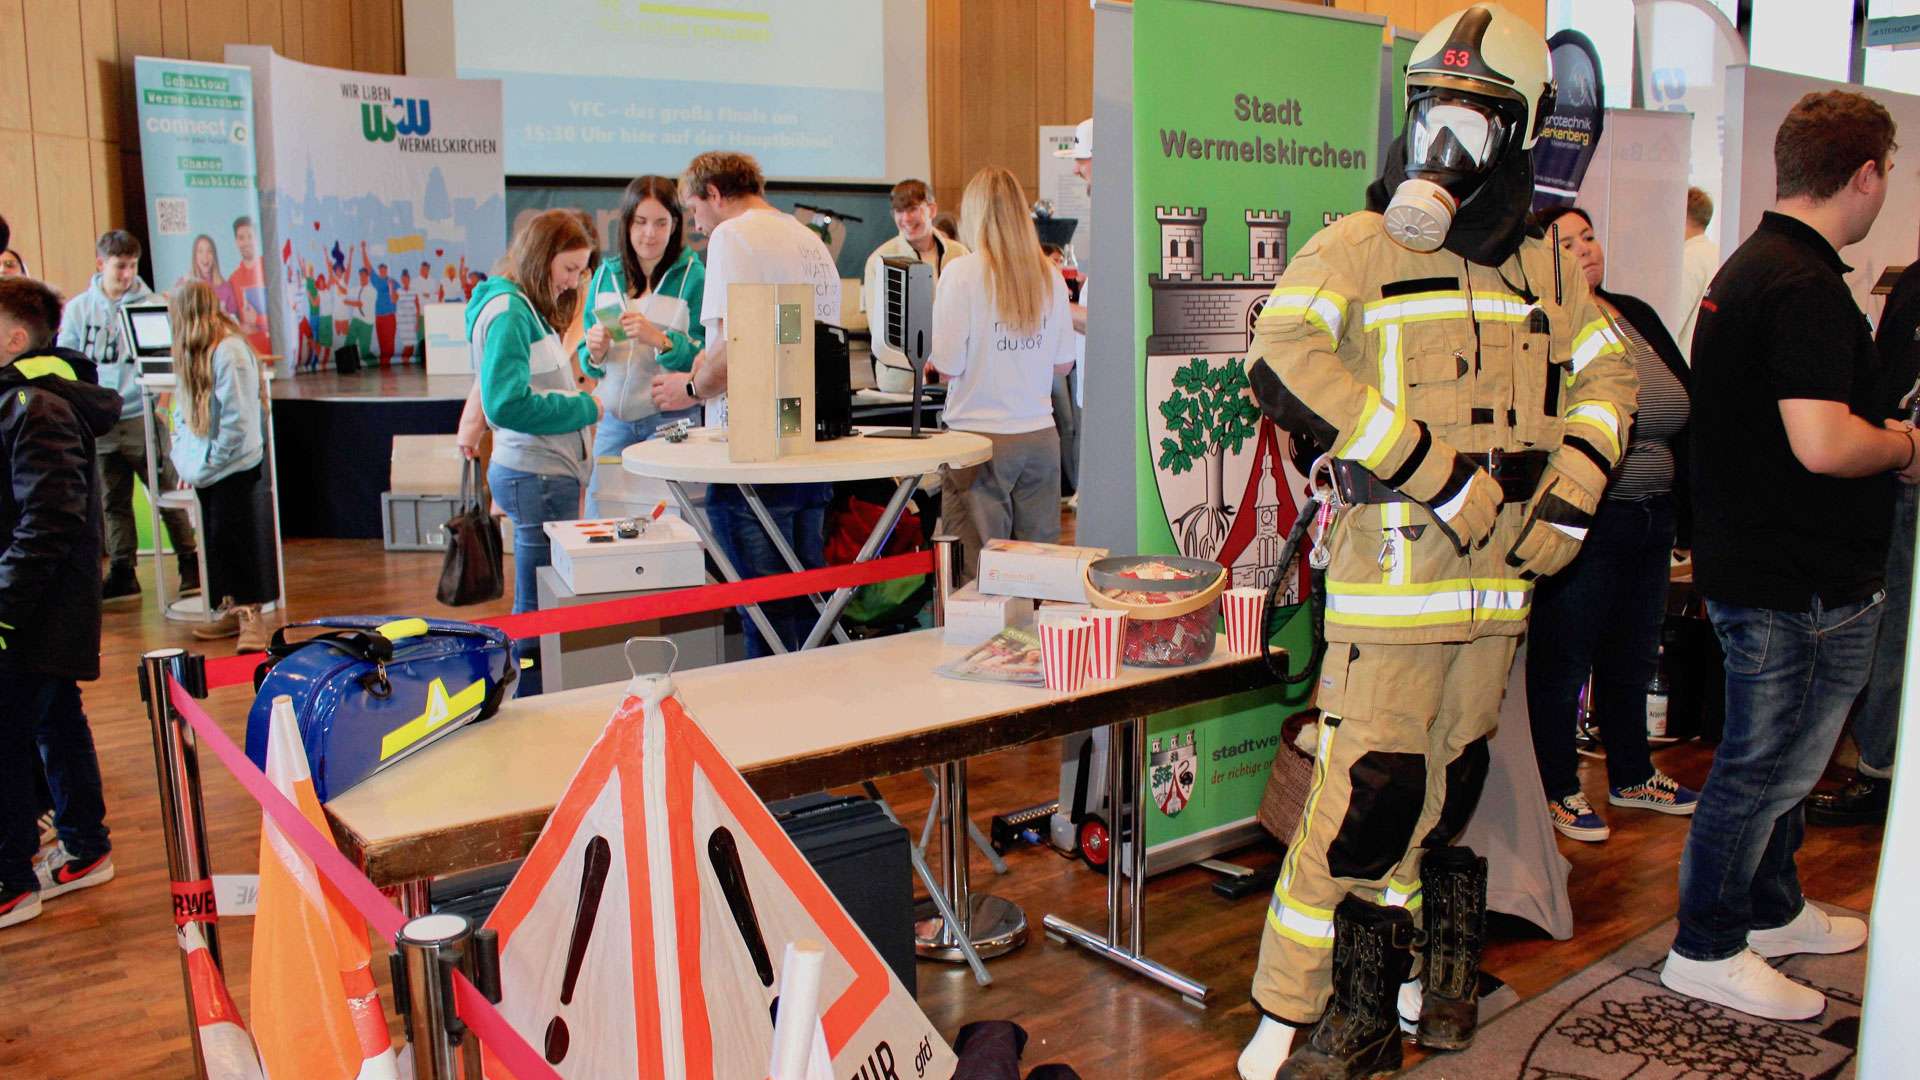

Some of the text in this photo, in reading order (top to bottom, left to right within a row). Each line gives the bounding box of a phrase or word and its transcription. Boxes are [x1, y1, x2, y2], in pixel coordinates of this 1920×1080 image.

[1443, 49, 1470, 68] 53
[340, 83, 360, 98] WIR
[569, 98, 606, 118] YFC
[624, 102, 656, 120] das
[1233, 92, 1303, 126] Stadt
[146, 117, 225, 136] connect
[581, 125, 615, 144] Uhr
[398, 136, 497, 154] WERMELSKIRCHEN
[1159, 128, 1368, 170] Wermelskirchen
[996, 334, 1043, 351] du so?
[1212, 735, 1280, 761] stadtwe
